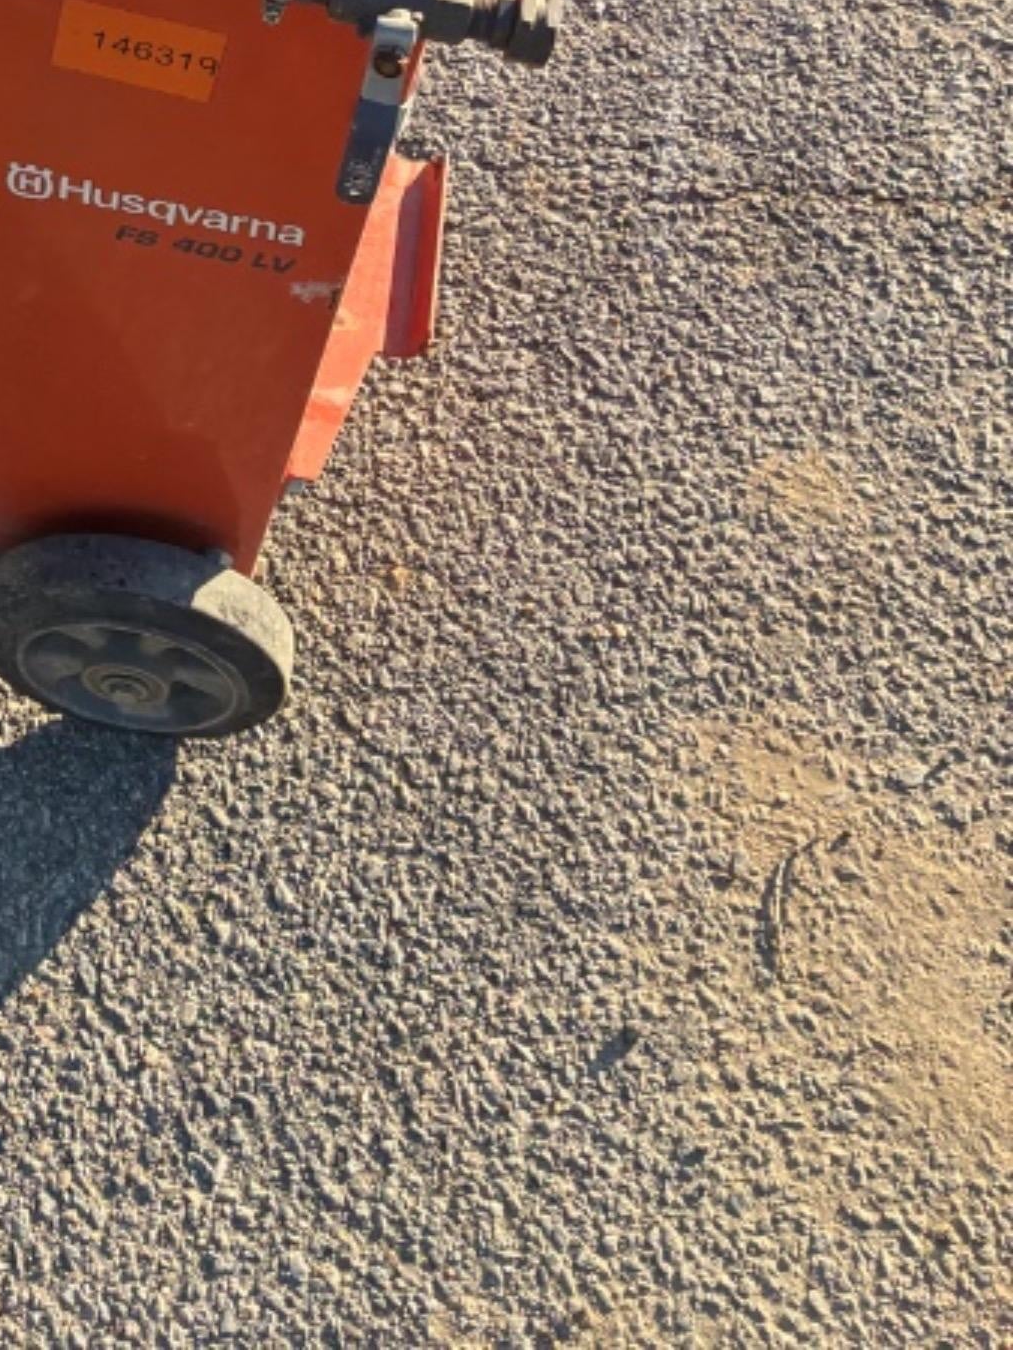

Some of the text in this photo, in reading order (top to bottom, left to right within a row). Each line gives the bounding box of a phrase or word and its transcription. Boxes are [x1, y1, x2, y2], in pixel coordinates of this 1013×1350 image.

[93, 30, 219, 77] 146319
[58, 176, 306, 247] Husqvarna
[115, 225, 297, 274] FS 400 LV
